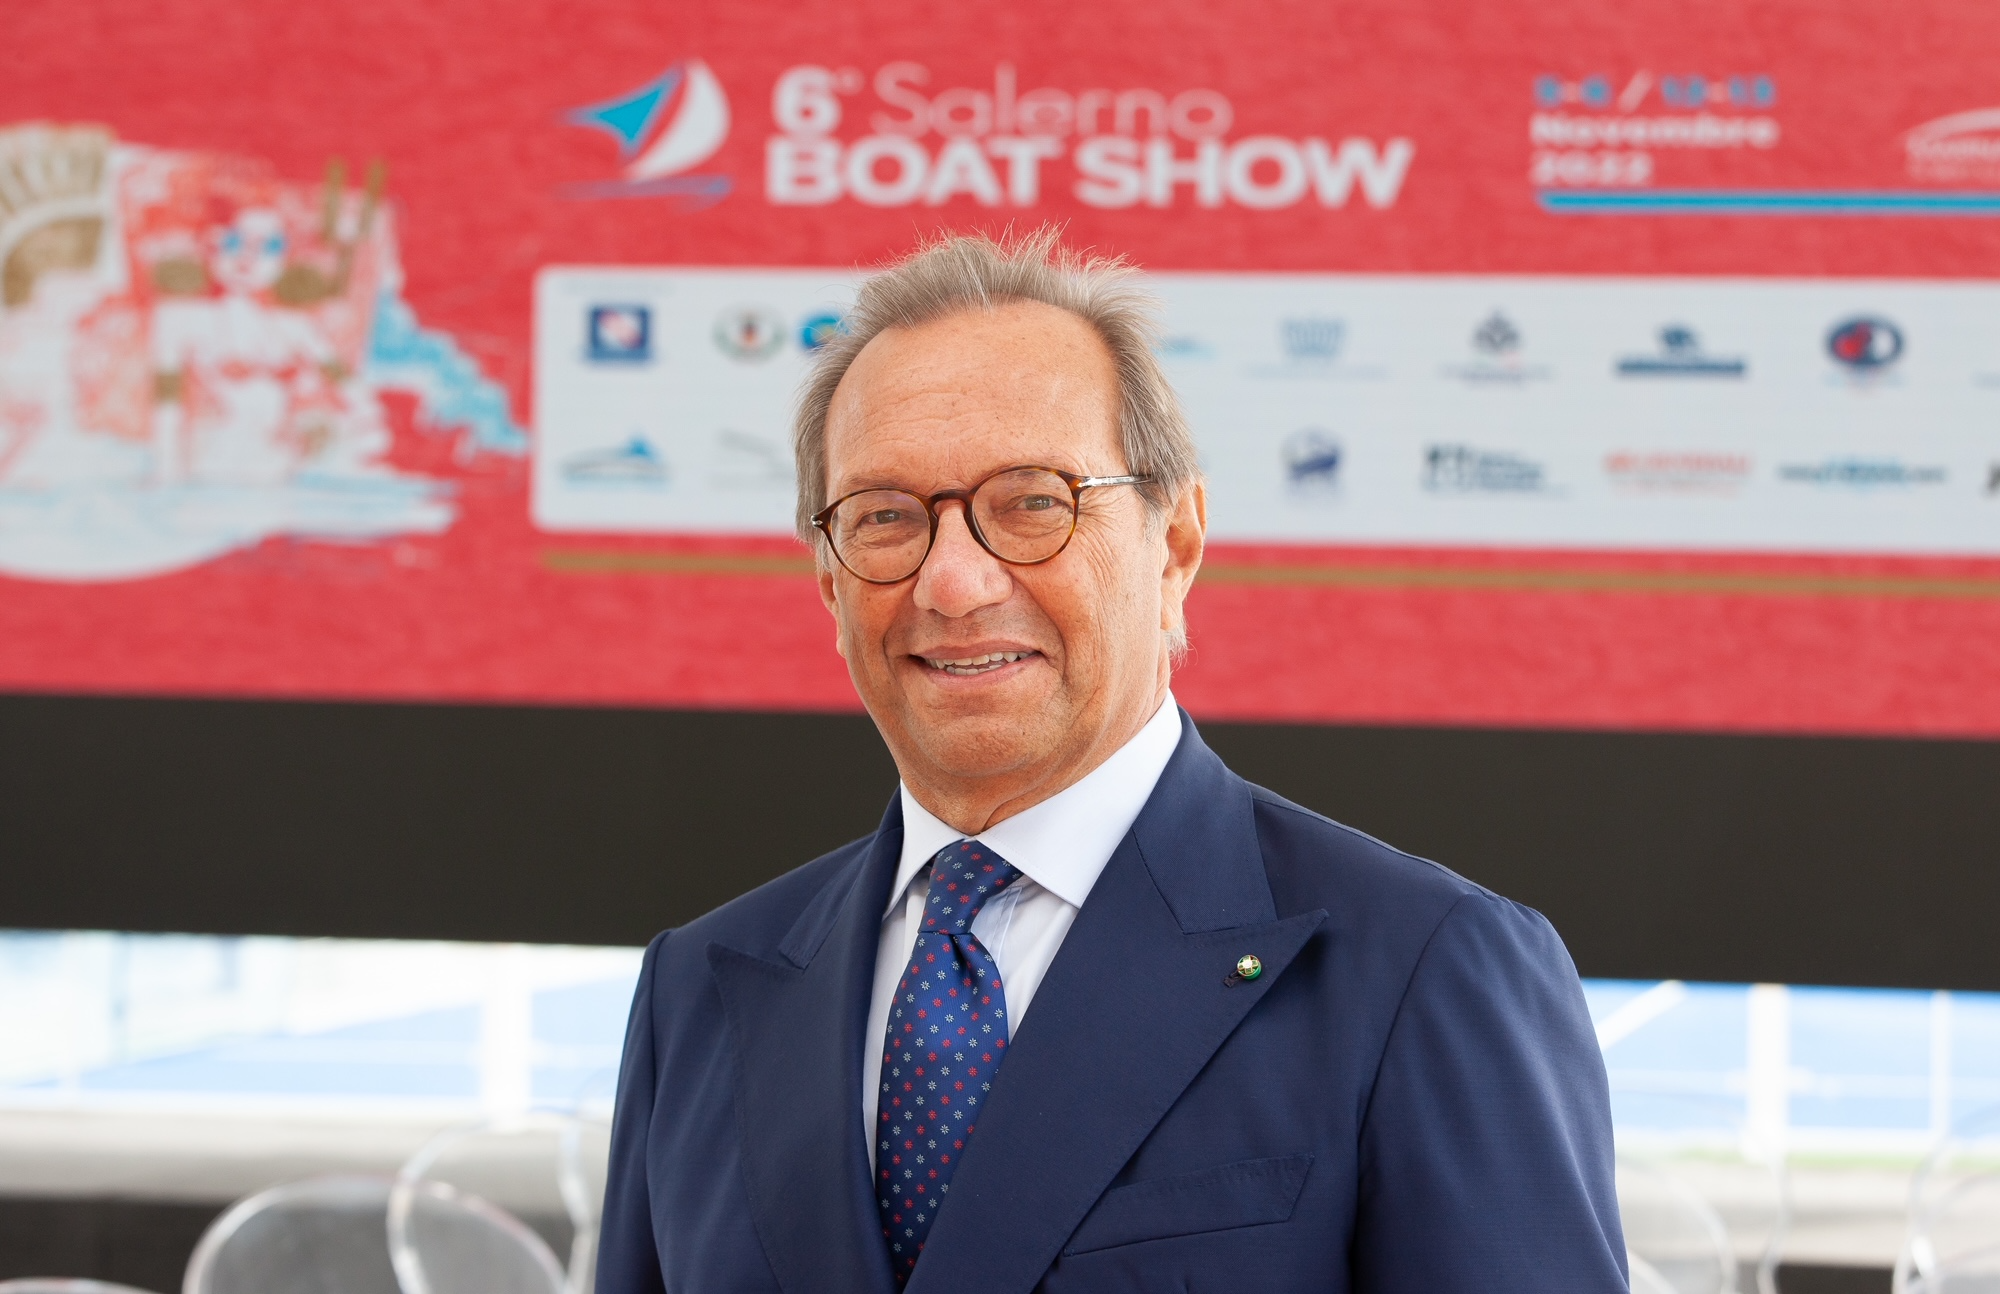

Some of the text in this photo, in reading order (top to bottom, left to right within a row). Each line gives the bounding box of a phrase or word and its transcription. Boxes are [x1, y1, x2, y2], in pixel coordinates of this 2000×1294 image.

[872, 63, 1231, 139] Salerno
[1531, 114, 1779, 148] Novembre
[767, 137, 1413, 209] BOAT SHOW
